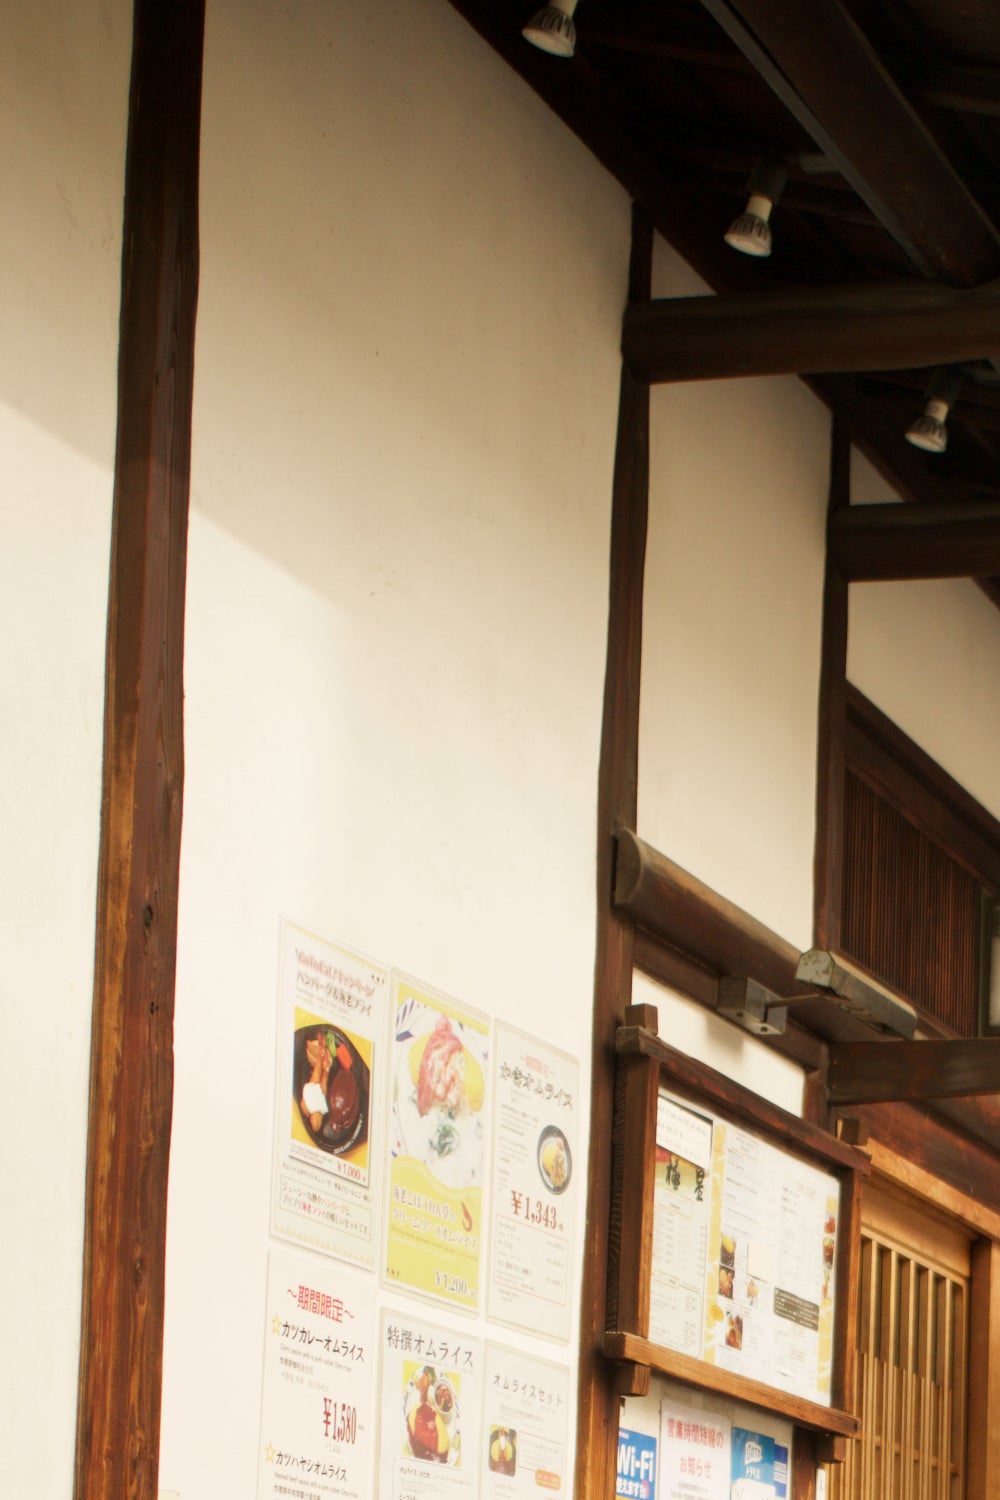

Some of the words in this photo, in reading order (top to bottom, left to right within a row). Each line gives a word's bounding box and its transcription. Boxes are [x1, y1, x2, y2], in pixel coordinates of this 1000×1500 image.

[511, 1190, 558, 1230] ¥1,343
[435, 1271, 467, 1295] ¥1,200
[282, 1321, 365, 1363] カツカレーオムライス
[386, 1325, 474, 1367] 特撰オムライス
[493, 1374, 562, 1408] オムライスセット
[323, 1397, 357, 1445] ¥1,580
[667, 1416, 724, 1448] 営業時間短縮の
[276, 1451, 348, 1482] カツハヤシオムライス
[617, 1443, 654, 1482] Wi-Fi
[680, 1455, 711, 1479] お知らせ
